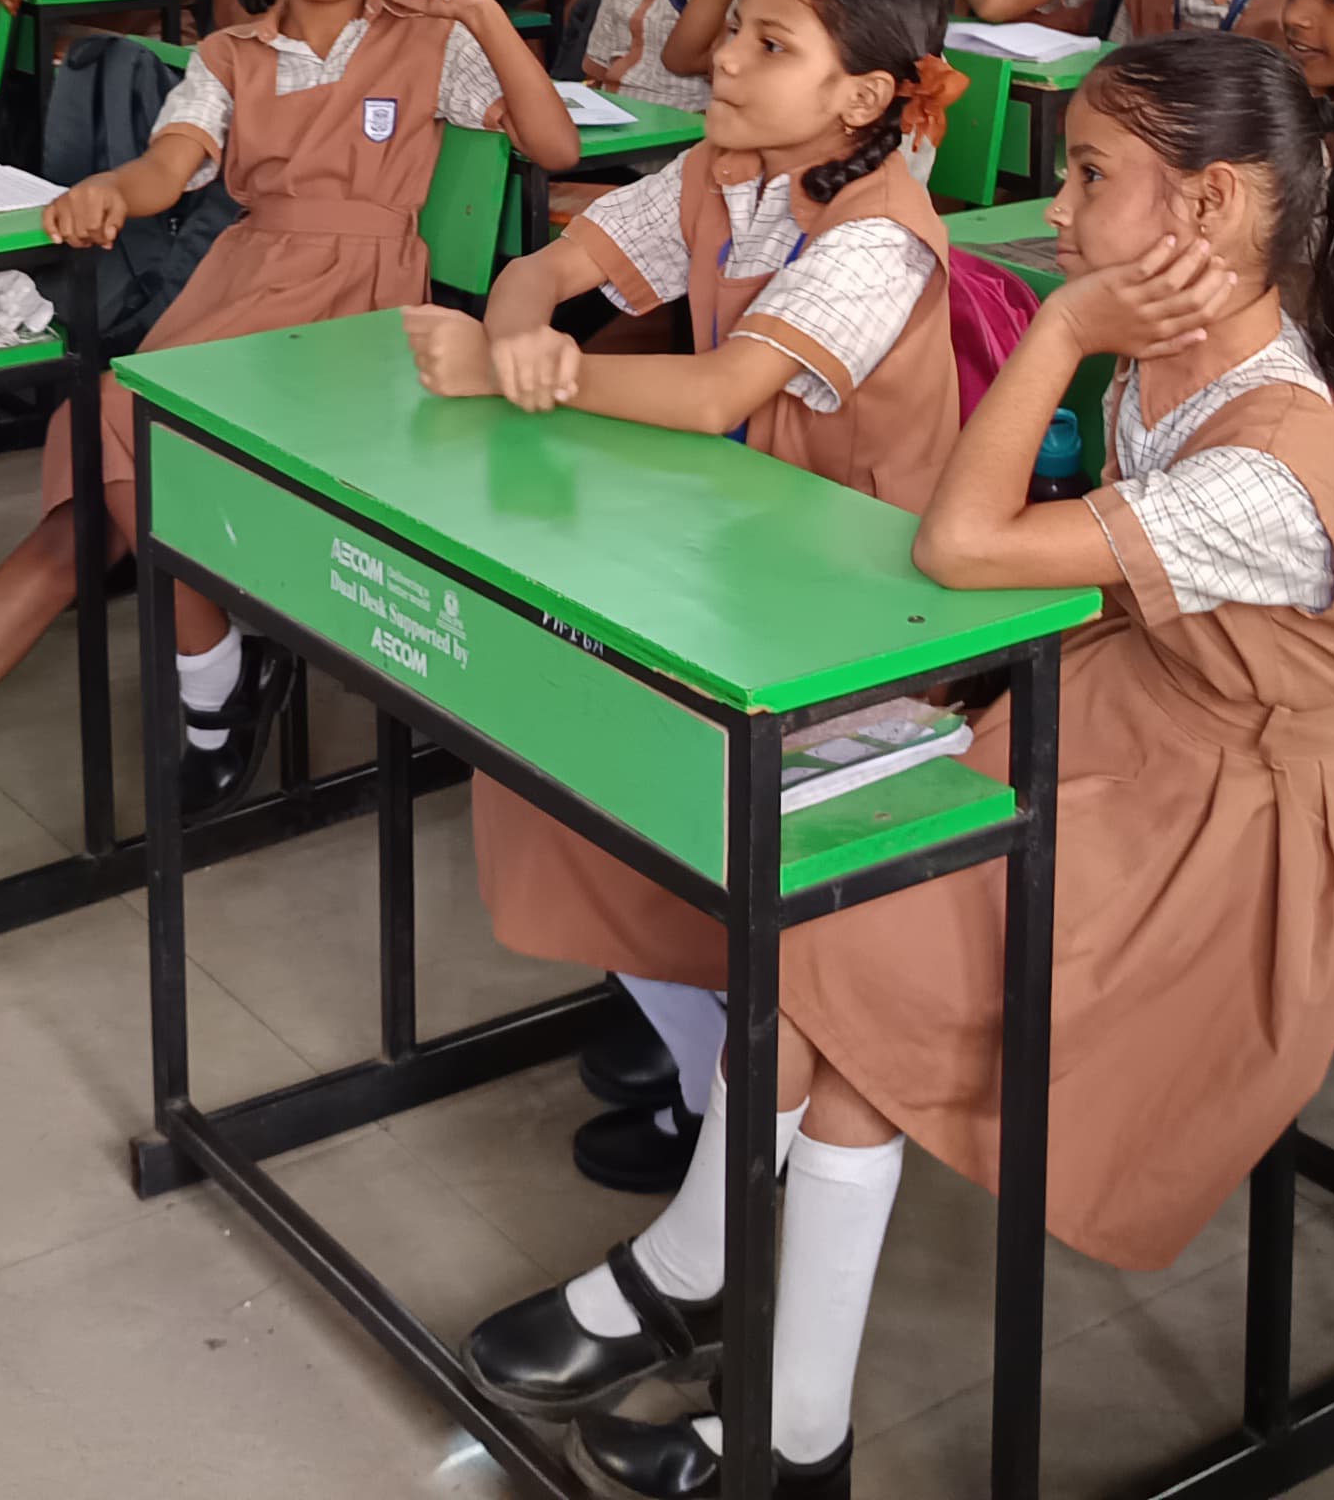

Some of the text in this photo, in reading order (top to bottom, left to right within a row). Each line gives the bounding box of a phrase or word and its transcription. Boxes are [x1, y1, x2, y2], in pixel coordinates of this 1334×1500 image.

[331, 537, 384, 586] AECOM
[331, 568, 357, 602] Dual
[359, 585, 388, 619] Desk
[389, 602, 451, 655] Supported
[453, 637, 469, 670] by
[371, 626, 427, 678] AECOM
